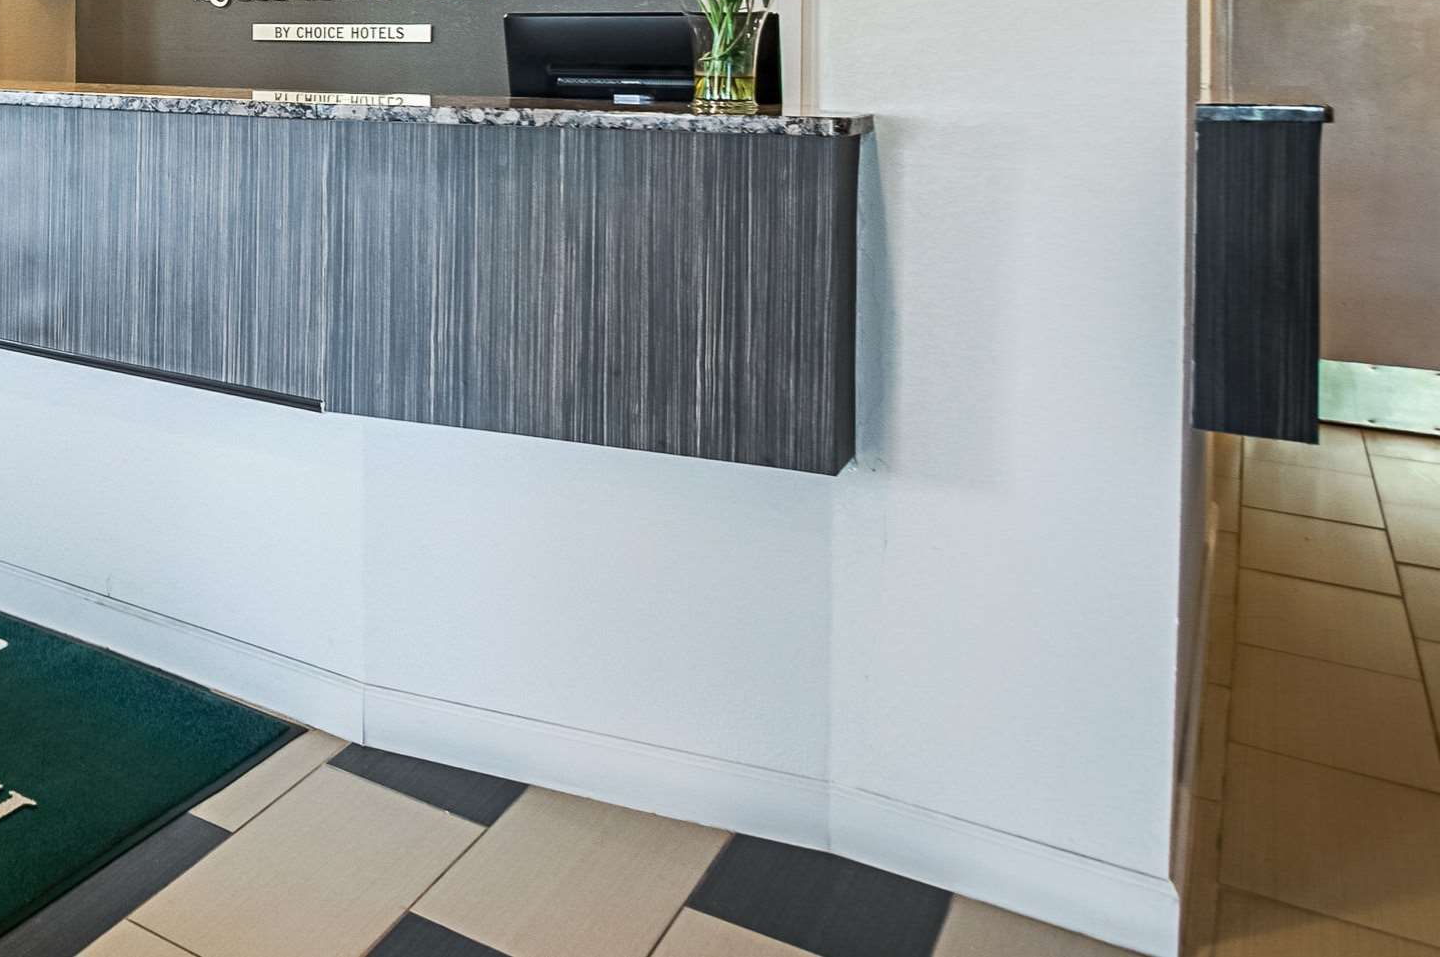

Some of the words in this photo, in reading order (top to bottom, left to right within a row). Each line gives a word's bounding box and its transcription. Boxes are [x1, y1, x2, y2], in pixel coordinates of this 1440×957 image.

[274, 26, 291, 39] BY
[296, 26, 345, 39] CHOICE
[351, 26, 405, 40] HOTELS
